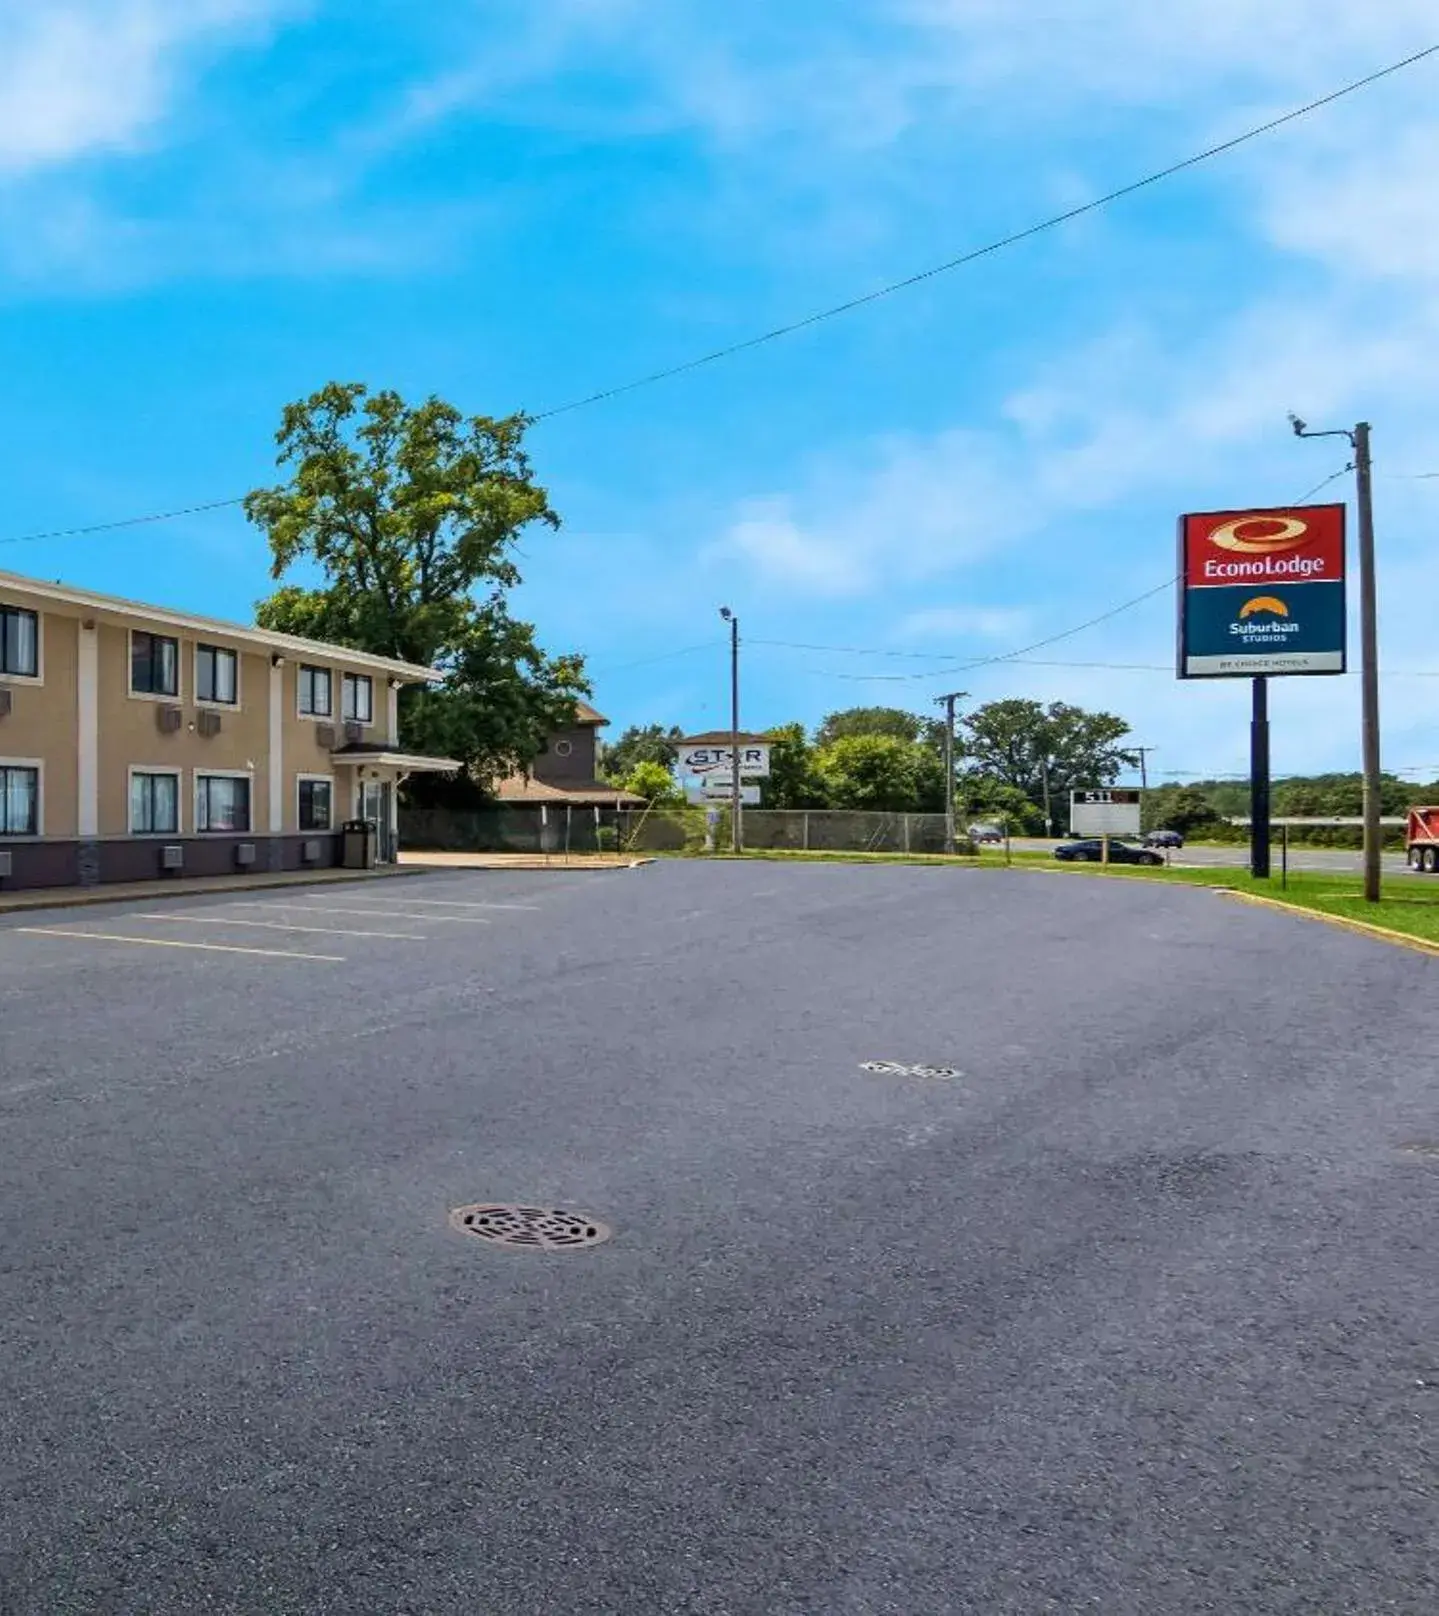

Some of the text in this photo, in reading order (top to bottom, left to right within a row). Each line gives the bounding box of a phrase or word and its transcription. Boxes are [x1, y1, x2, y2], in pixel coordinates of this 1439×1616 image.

[1204, 556, 1325, 577] EconoLodge
[1228, 621, 1300, 634] Suburban
[1242, 634, 1288, 643] STUDIOS
[693, 750, 762, 762] STR
